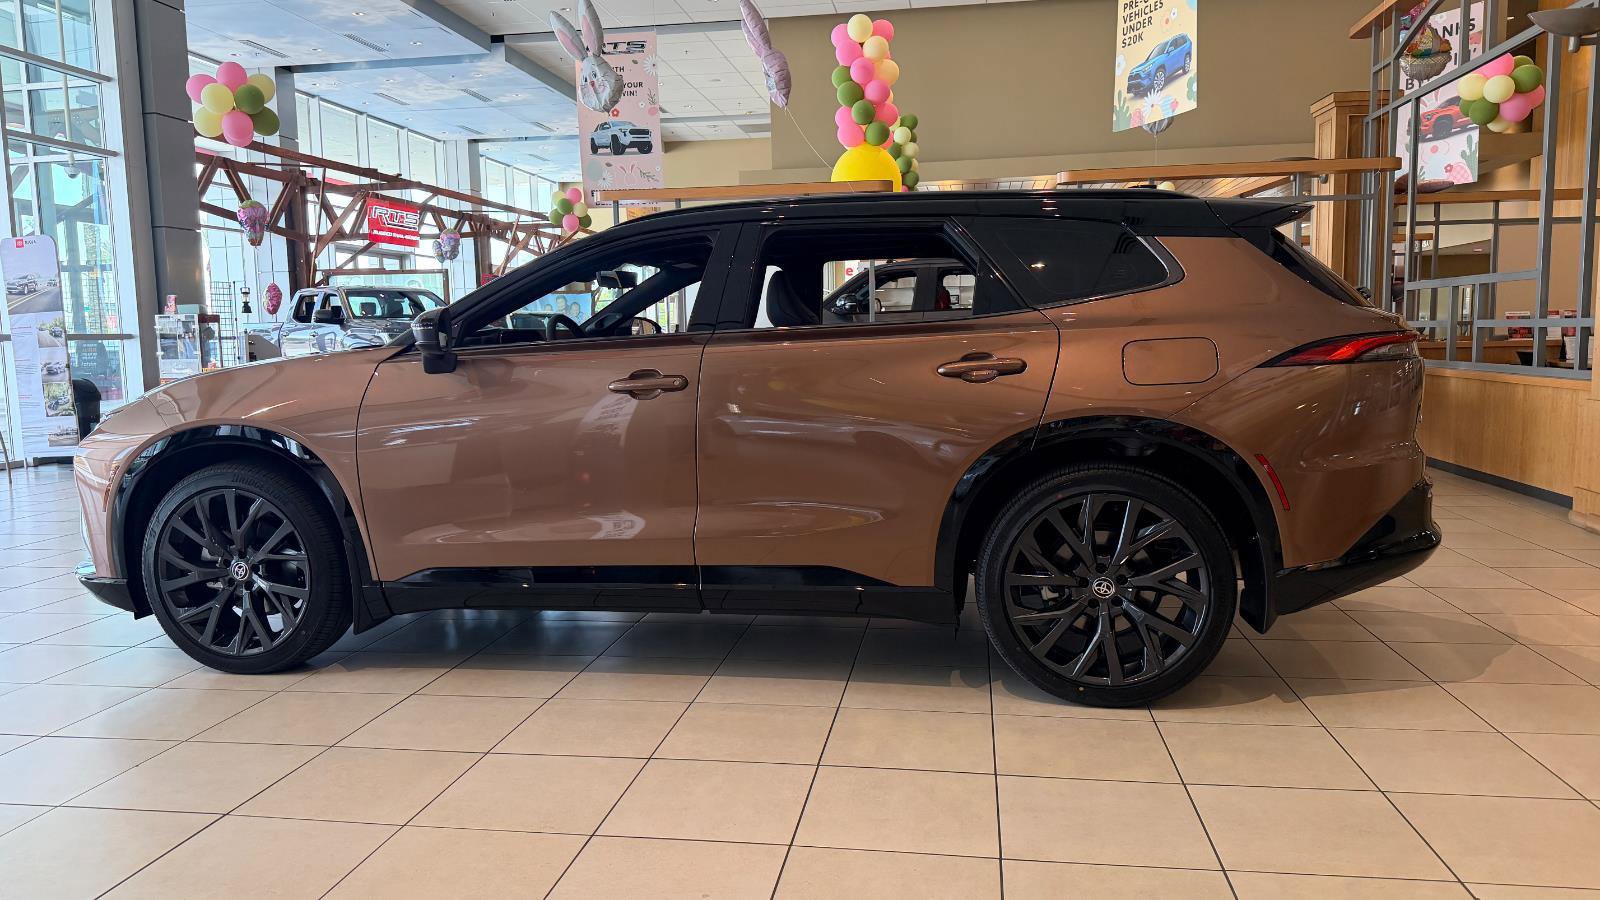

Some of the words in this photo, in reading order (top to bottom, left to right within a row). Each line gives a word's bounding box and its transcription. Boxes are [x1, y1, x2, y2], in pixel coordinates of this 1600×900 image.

[1122, 0, 1163, 24] VEHICLES
[1122, 16, 1152, 36] UNDER
[1121, 31, 1144, 48] $20K
[369, 205, 420, 232] RTS
